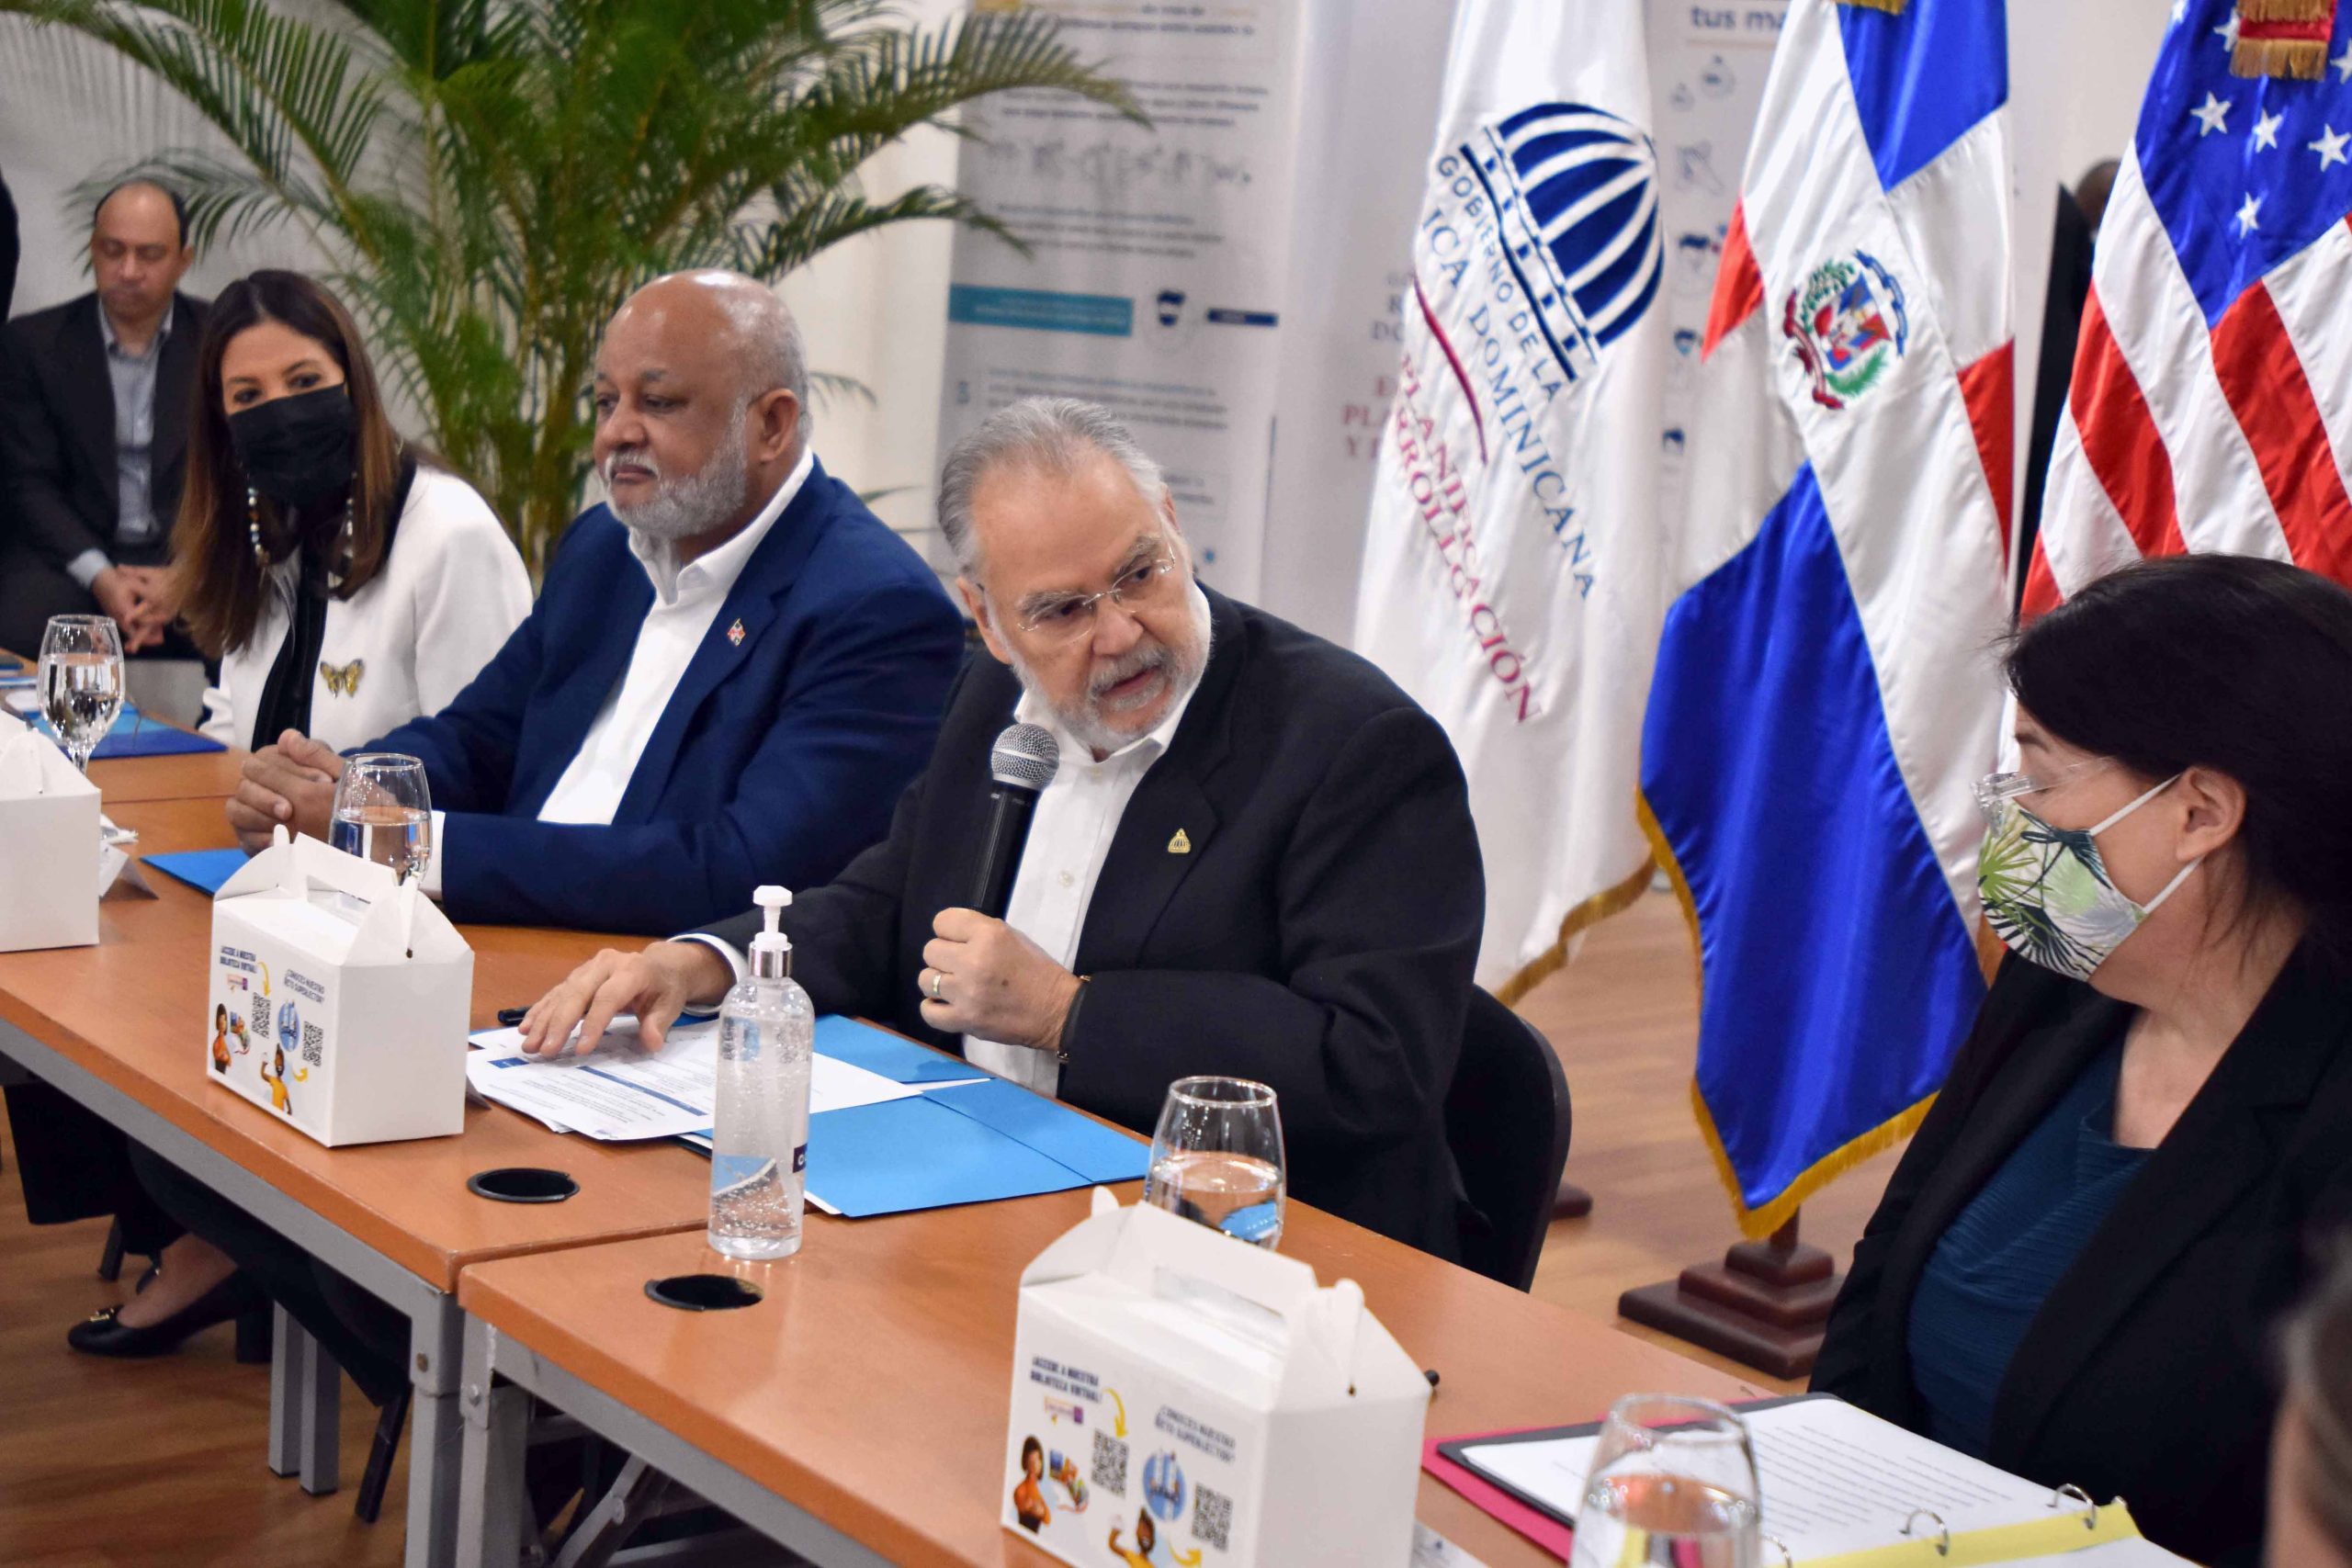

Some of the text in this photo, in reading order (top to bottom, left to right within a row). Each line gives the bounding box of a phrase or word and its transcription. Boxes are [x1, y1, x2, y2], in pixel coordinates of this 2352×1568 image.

[1437, 155, 1563, 402] GOBIERNO DE LA
[1468, 303, 1594, 601] DOMINICANA
